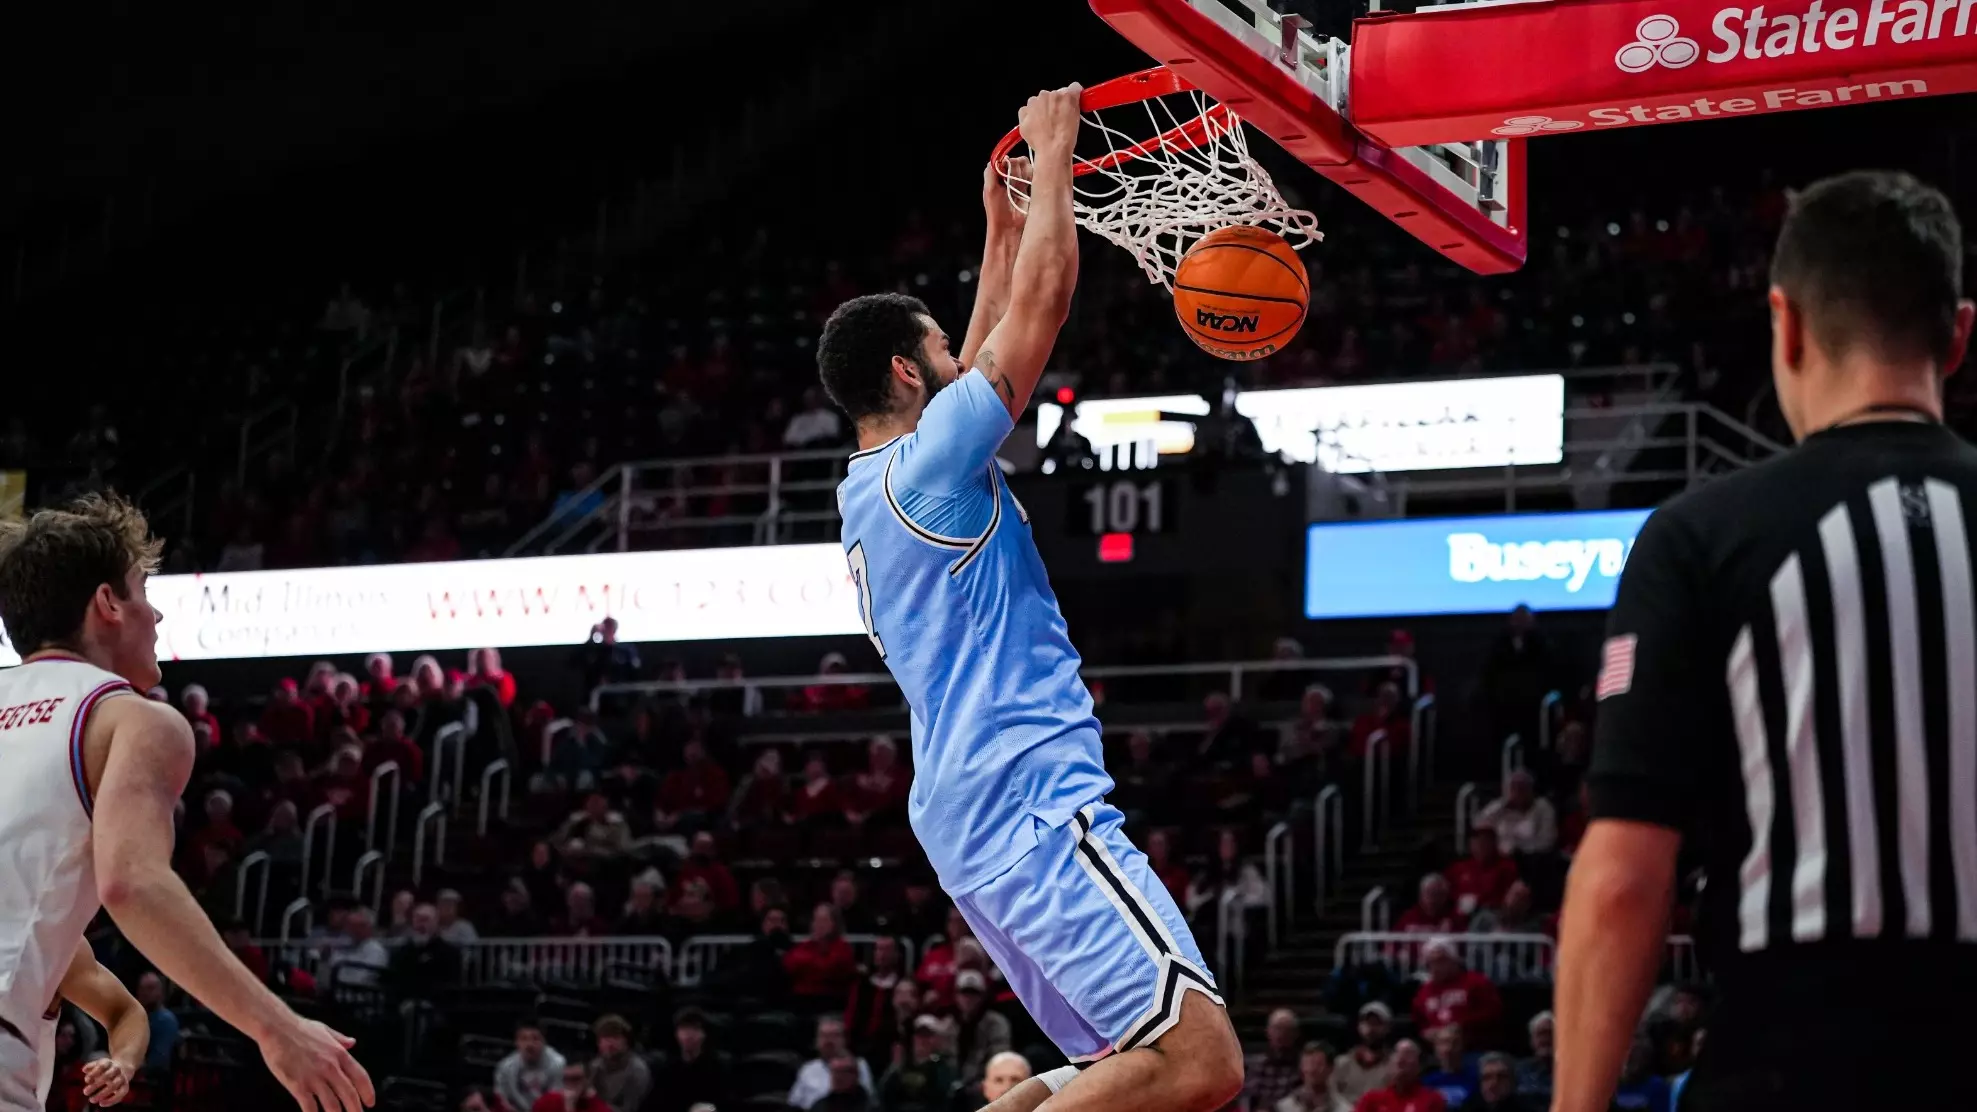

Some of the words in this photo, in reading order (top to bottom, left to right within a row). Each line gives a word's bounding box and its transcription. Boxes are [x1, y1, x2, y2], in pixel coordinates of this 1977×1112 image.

[1588, 97, 1757, 126] State
[1763, 79, 1927, 109] Farm
[1197, 308, 1259, 333] NCAA
[1082, 479, 1163, 534] 101
[1446, 532, 1598, 593] Busey
[0, 697, 66, 730] EGTSE
